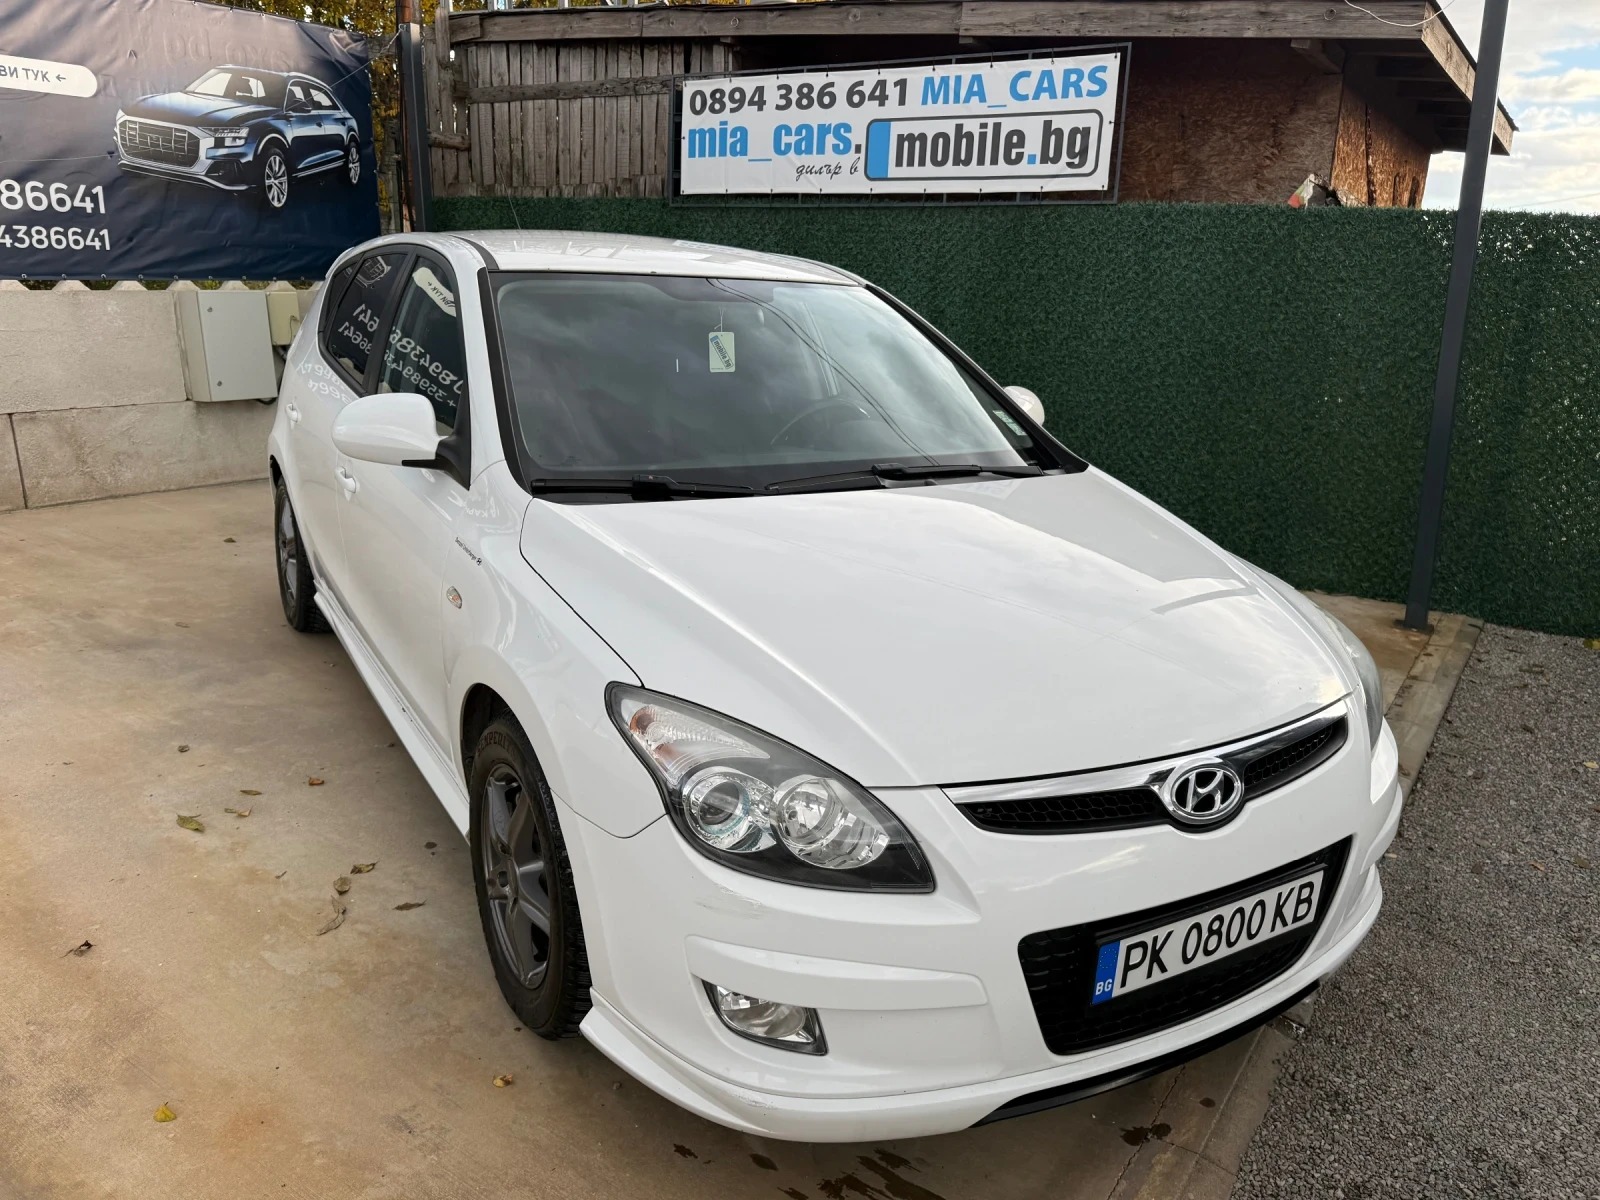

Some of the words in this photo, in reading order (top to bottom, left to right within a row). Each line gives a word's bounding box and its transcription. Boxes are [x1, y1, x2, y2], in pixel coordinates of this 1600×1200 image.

[22, 68, 50, 82] ТУК
[689, 85, 766, 115] 0894
[775, 82, 836, 110] 386
[846, 79, 907, 108] 641
[921, 65, 1108, 108] MIA_CARS
[895, 120, 1091, 169] mobile.bg
[796, 162, 842, 181] дилър
[0, 179, 105, 214] 86641
[713, 340, 732, 368] mobile.bg
[1096, 978, 1112, 996] BG
[1120, 930, 1174, 989] PK
[1181, 899, 1266, 965] 0800
[1270, 881, 1315, 933] KB
